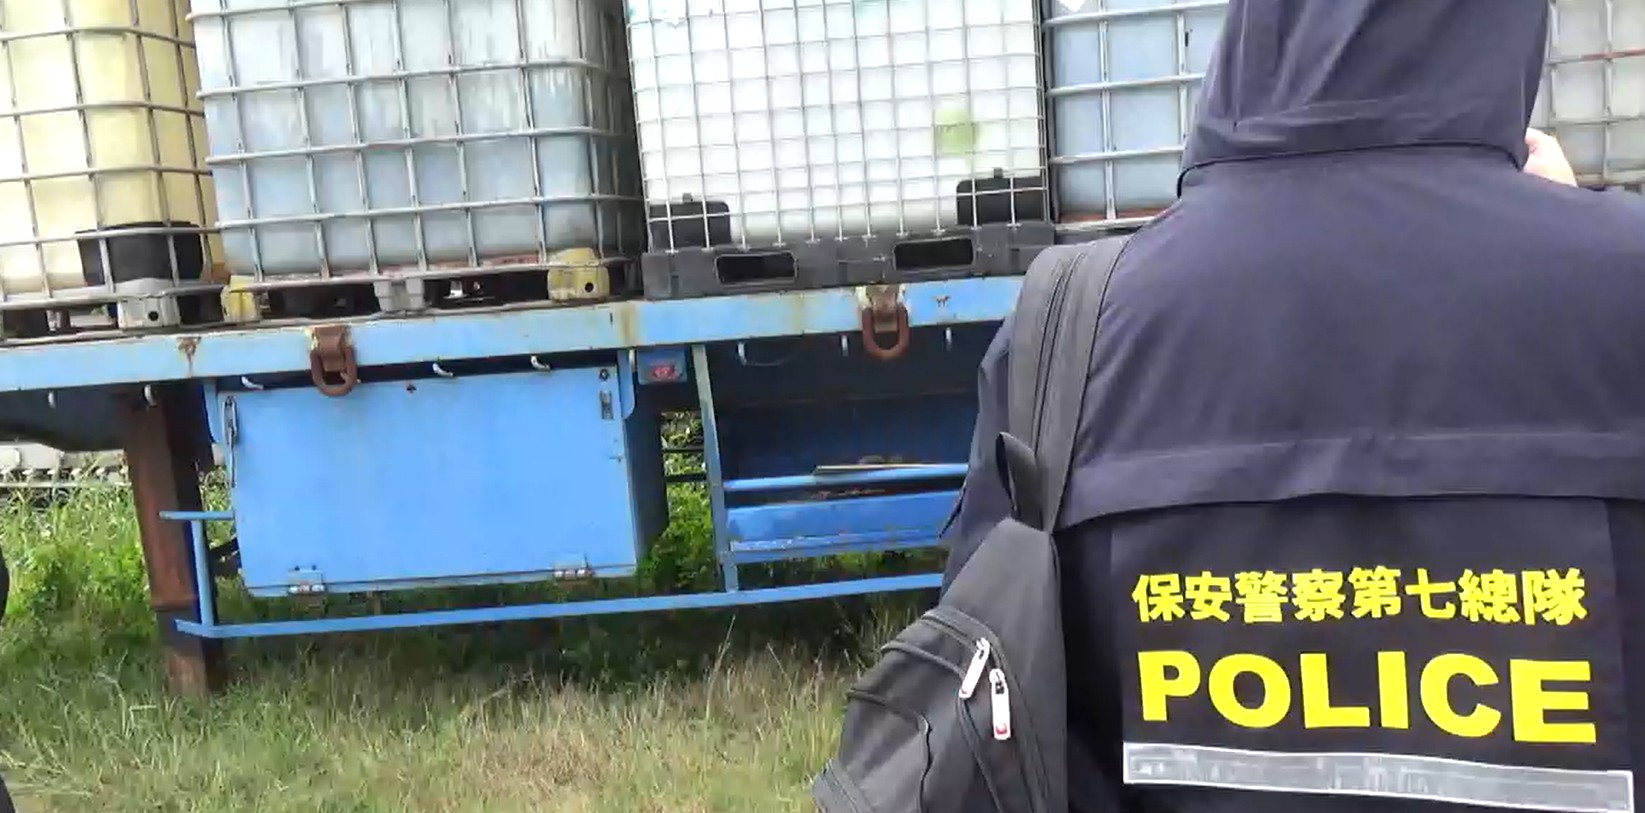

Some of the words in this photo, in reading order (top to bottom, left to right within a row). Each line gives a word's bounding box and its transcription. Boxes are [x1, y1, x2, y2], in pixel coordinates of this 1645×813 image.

[1132, 566, 1588, 626] 保安警察第七總隊
[1138, 650, 1597, 743] POLICE
